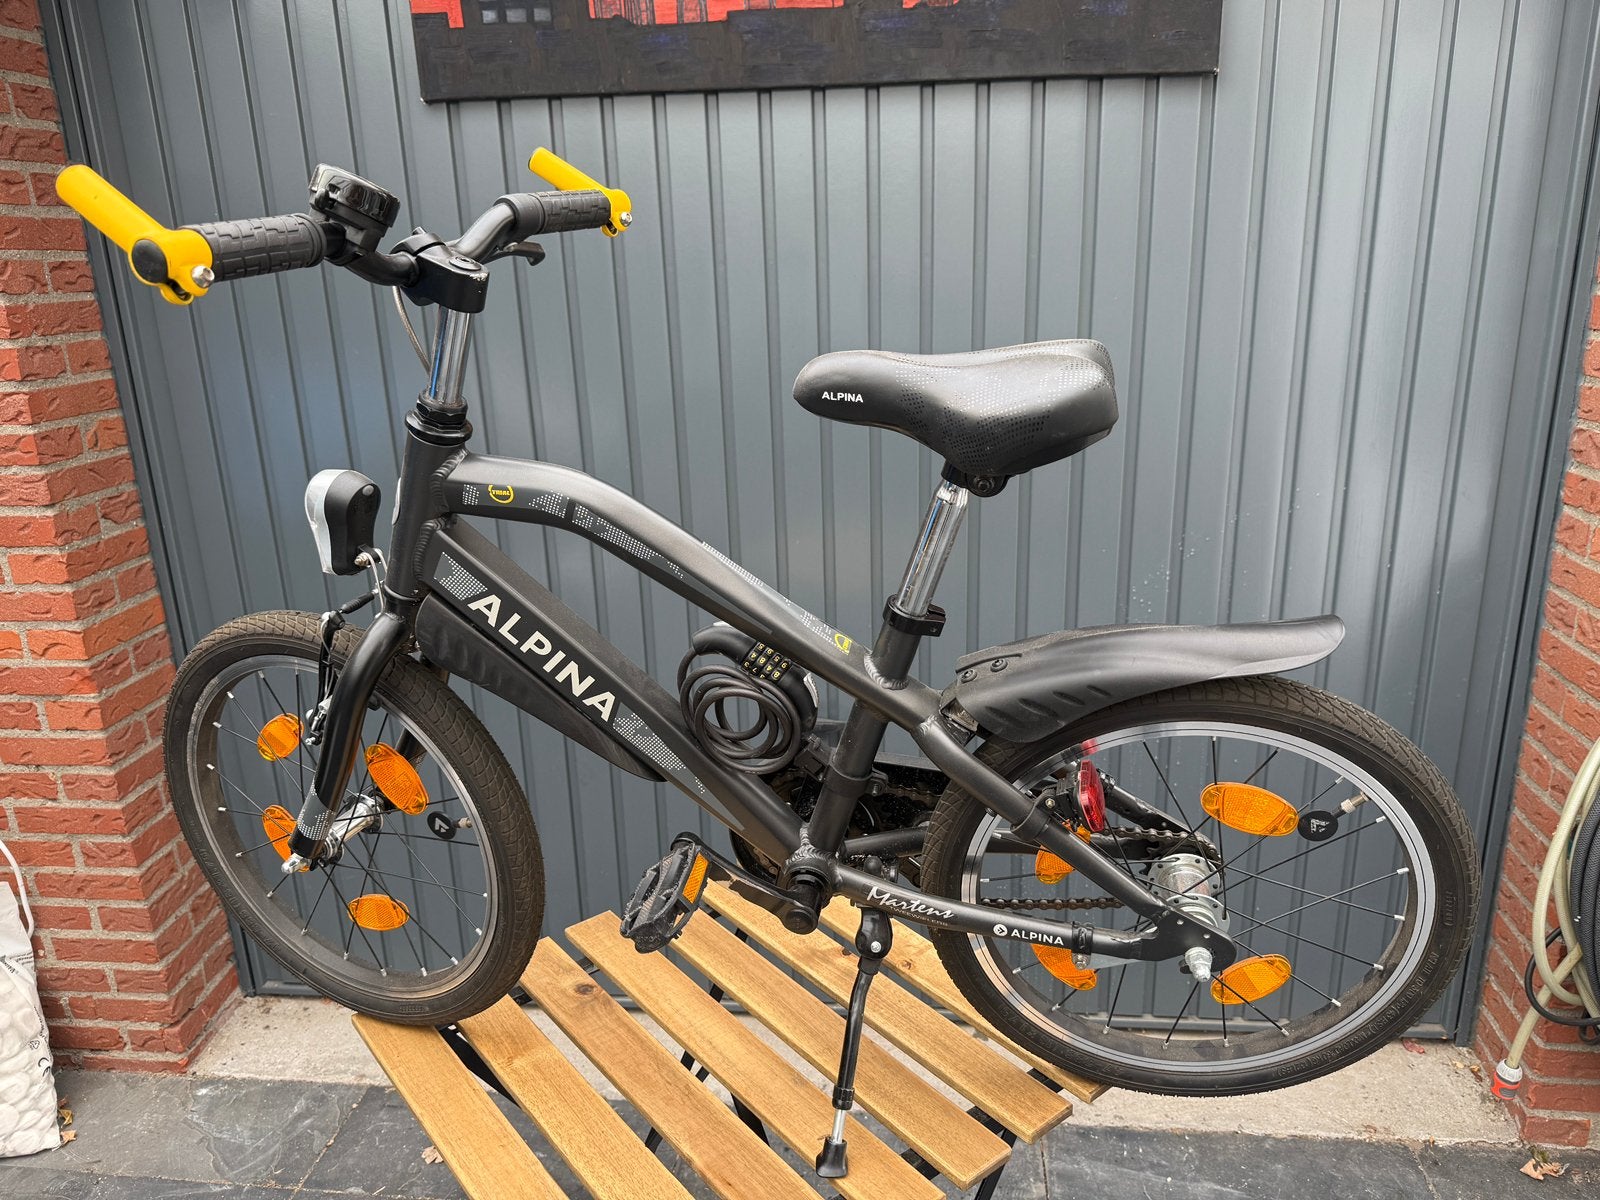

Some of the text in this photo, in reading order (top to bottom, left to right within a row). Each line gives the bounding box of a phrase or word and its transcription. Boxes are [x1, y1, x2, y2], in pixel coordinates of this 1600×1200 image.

[821, 391, 864, 403] ALPINA
[467, 594, 616, 722] ALPINA
[866, 886, 955, 919] Martens
[1010, 928, 1065, 946] ALPINA
